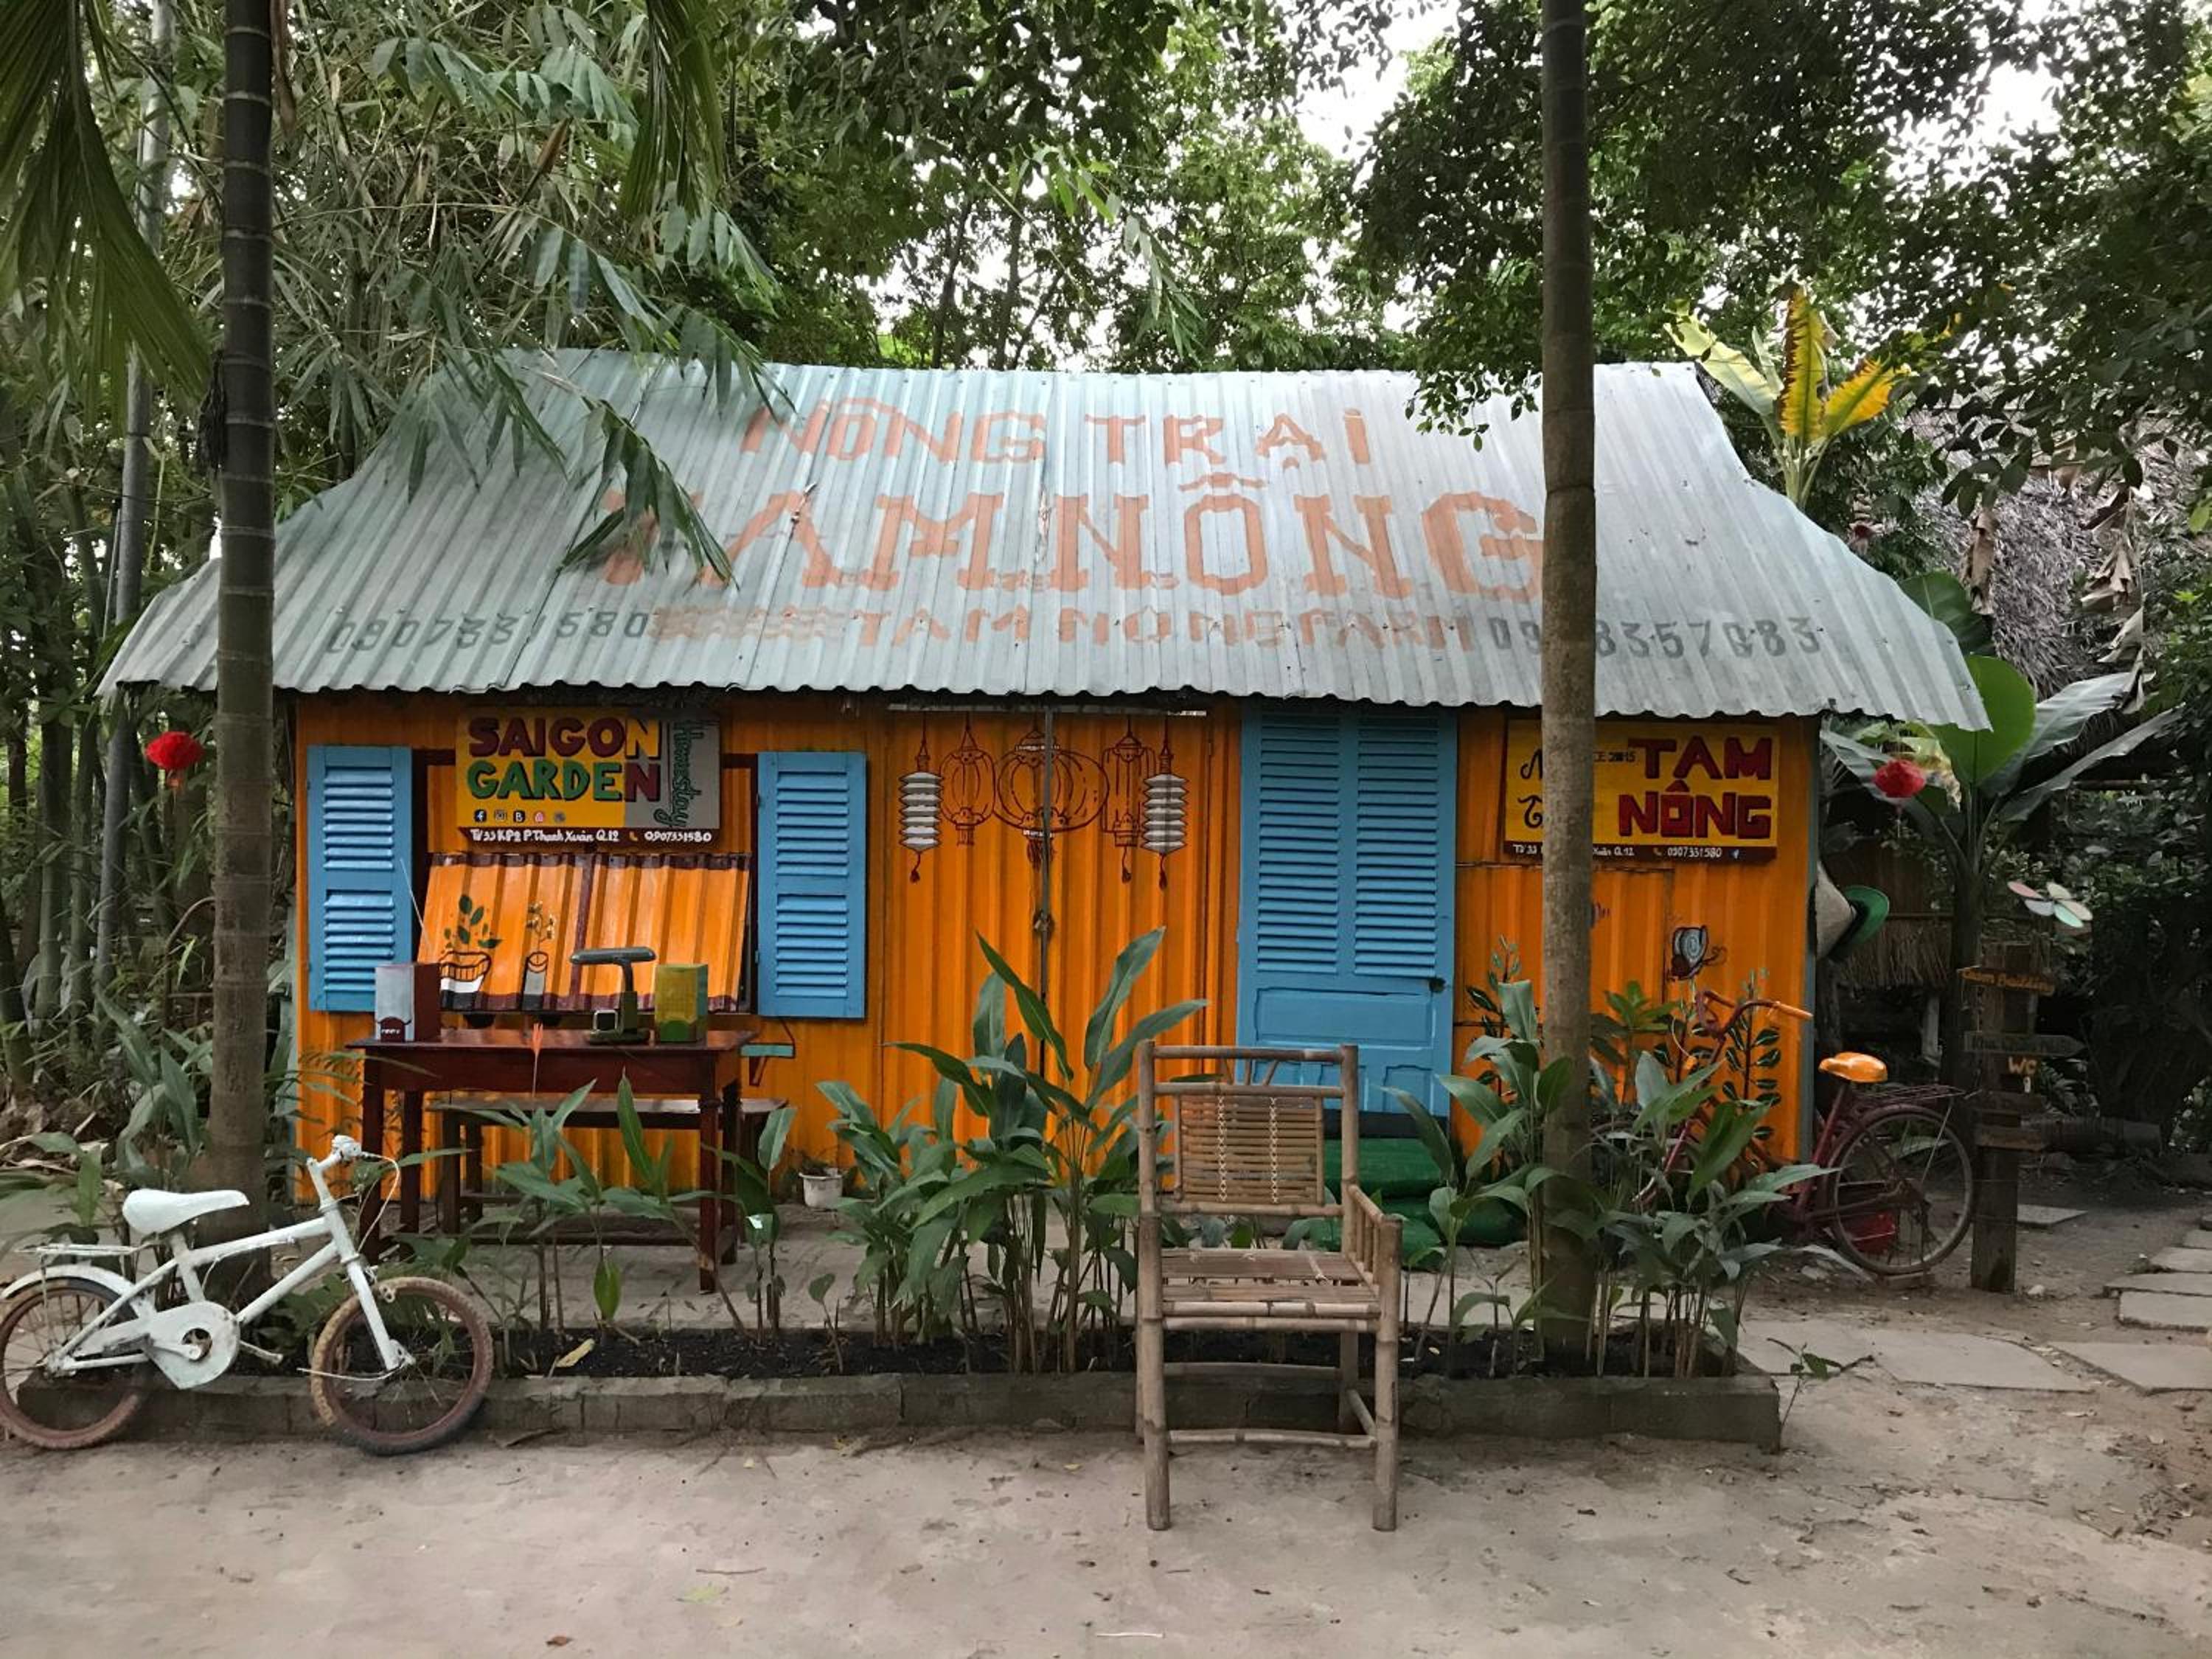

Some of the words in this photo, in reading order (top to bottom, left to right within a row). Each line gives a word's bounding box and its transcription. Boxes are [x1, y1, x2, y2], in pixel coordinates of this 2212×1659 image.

[1488, 616, 1820, 658] 098357083
[468, 717, 661, 759] SAIGON
[467, 759, 661, 802] GARDEN
[1619, 779, 1771, 839] NÔNG
[2008, 1057, 2037, 1075] WC
